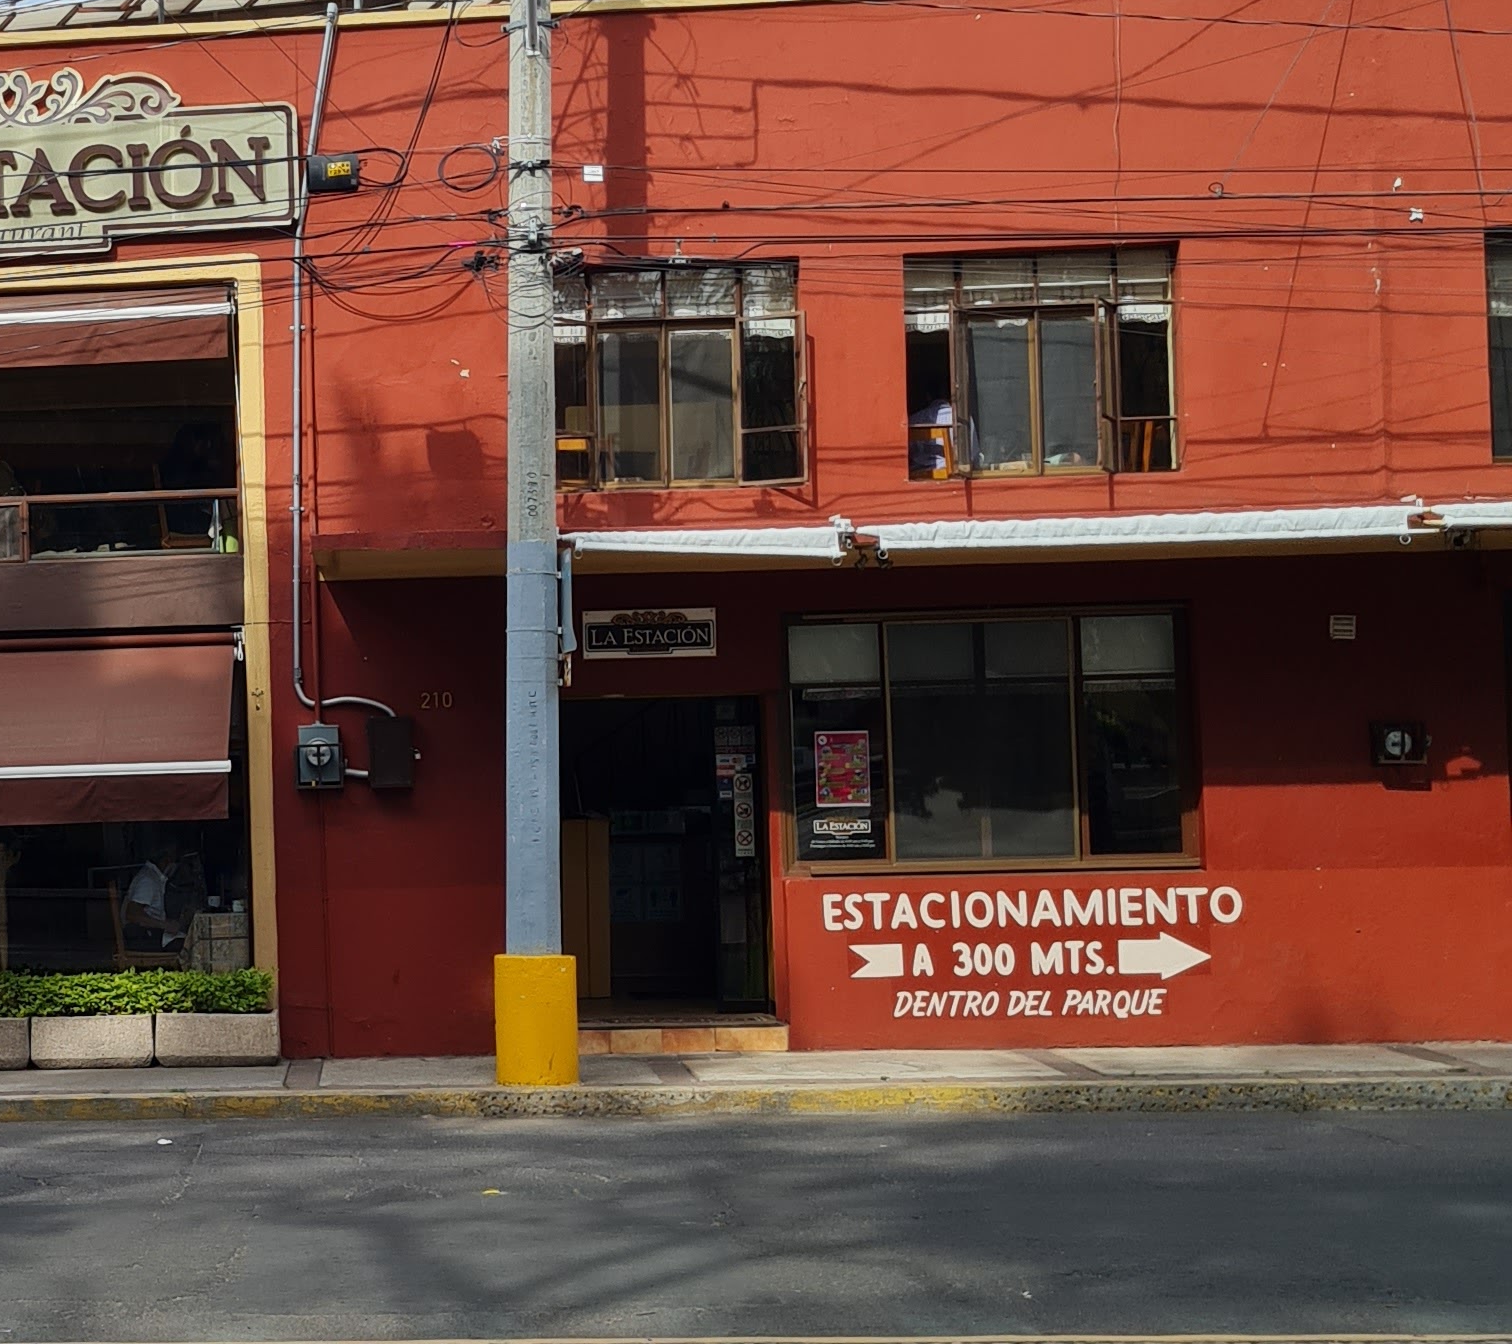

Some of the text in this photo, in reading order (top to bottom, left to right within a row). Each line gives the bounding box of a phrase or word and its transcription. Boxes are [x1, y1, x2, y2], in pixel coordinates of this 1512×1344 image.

[591, 625, 709, 646] LA ESTACIÓN
[421, 692, 453, 709] 210
[816, 822, 829, 831] LA
[821, 885, 1243, 932] ESTACIONAMIENTO
[912, 940, 1116, 978] A 300 MTS.
[892, 987, 1168, 1019] DENTRO DEL PARQUE
